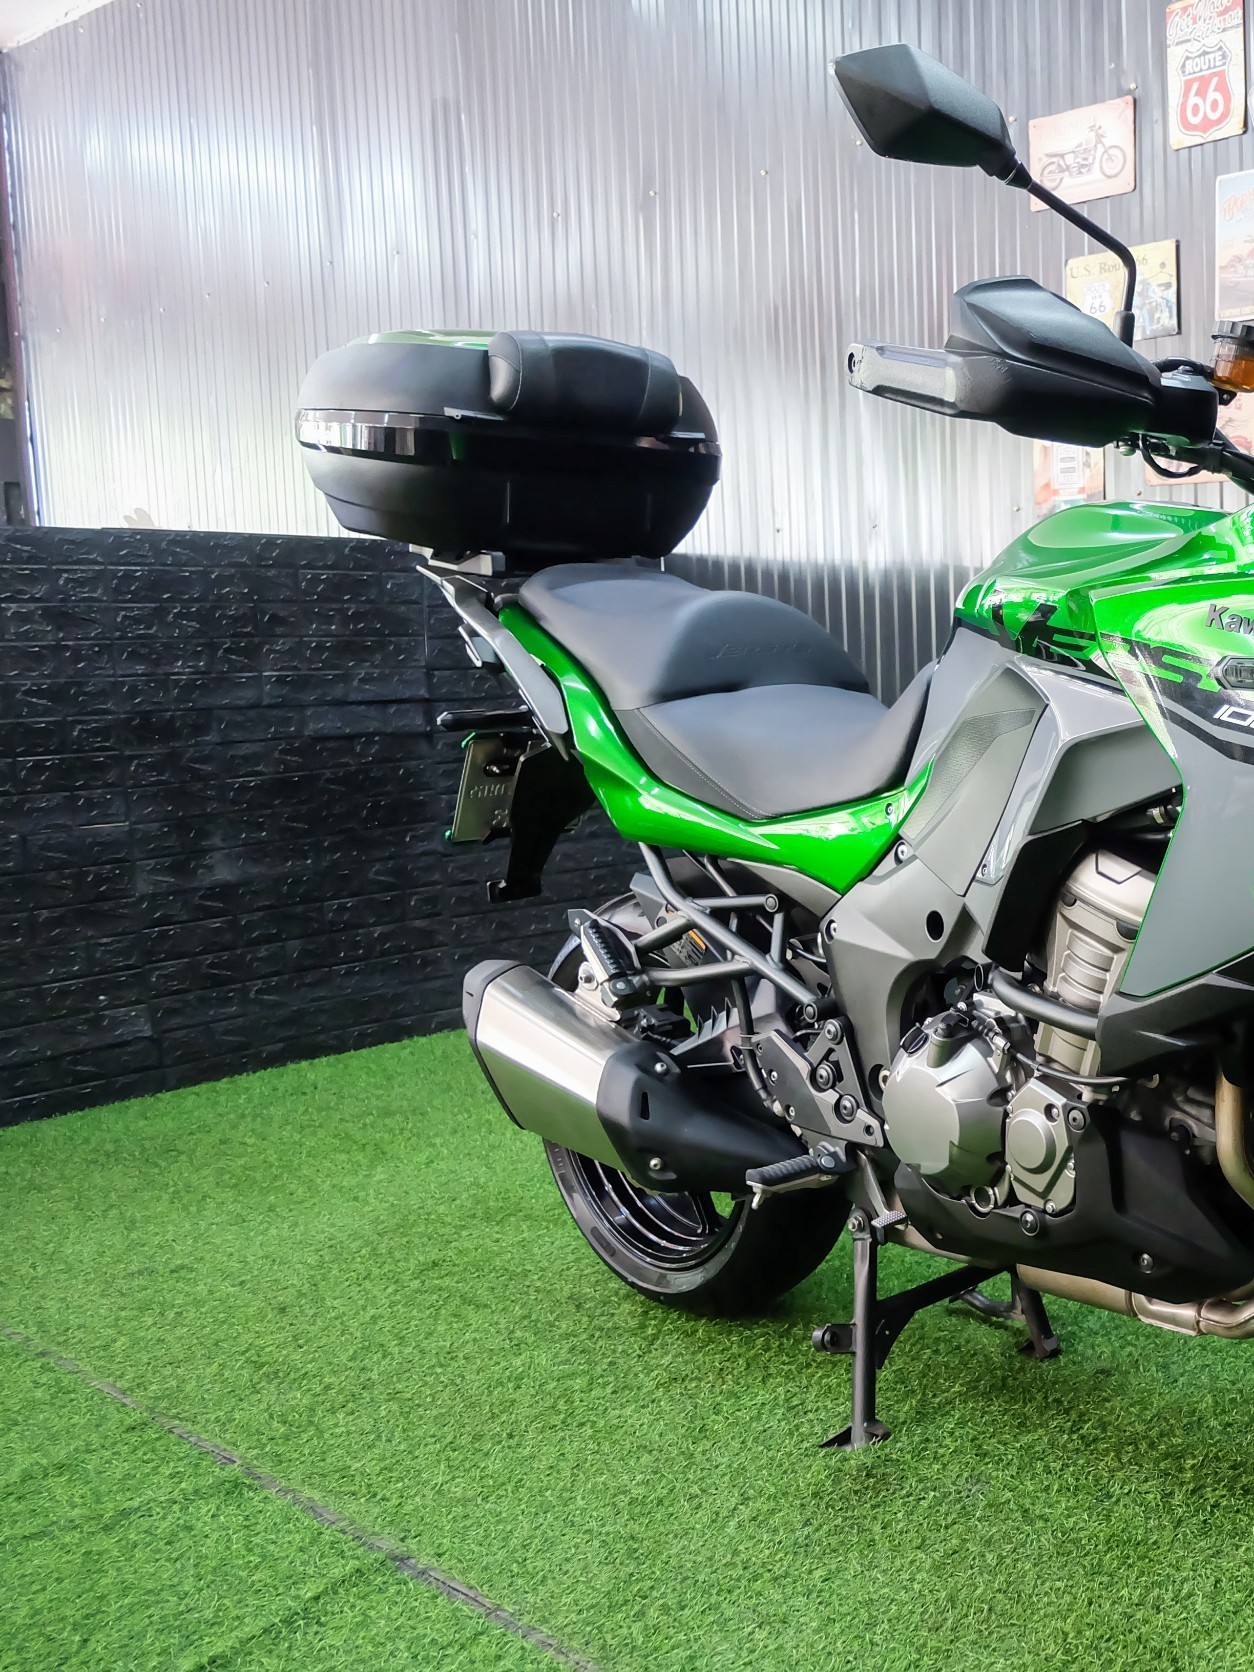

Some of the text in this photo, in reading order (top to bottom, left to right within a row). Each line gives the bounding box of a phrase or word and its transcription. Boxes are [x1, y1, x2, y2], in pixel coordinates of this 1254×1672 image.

[1185, 52, 1226, 75] ROUTE
[1186, 76, 1224, 125] 66
[1070, 264, 1095, 279] U.S.
[1089, 300, 1106, 314] 66
